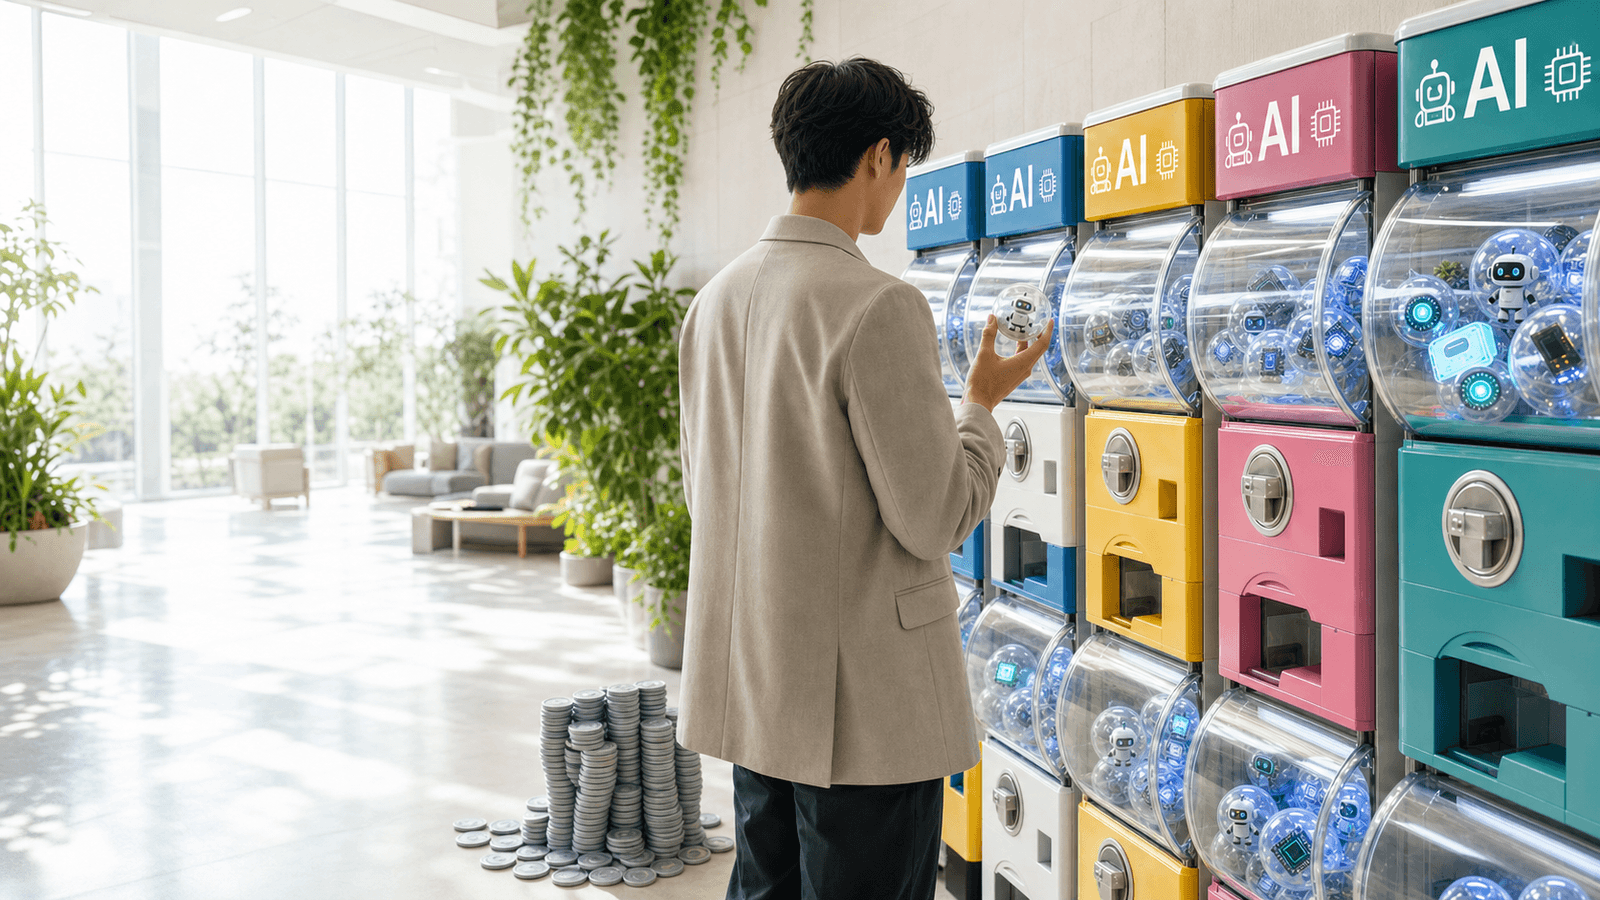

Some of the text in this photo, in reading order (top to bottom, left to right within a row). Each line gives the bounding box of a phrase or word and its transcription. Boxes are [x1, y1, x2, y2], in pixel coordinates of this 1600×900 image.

[1463, 38, 1527, 119] AI
[1257, 94, 1300, 162] AI
[1008, 164, 1033, 211] AI
[1114, 134, 1147, 190] AI
[923, 186, 944, 228] AI
